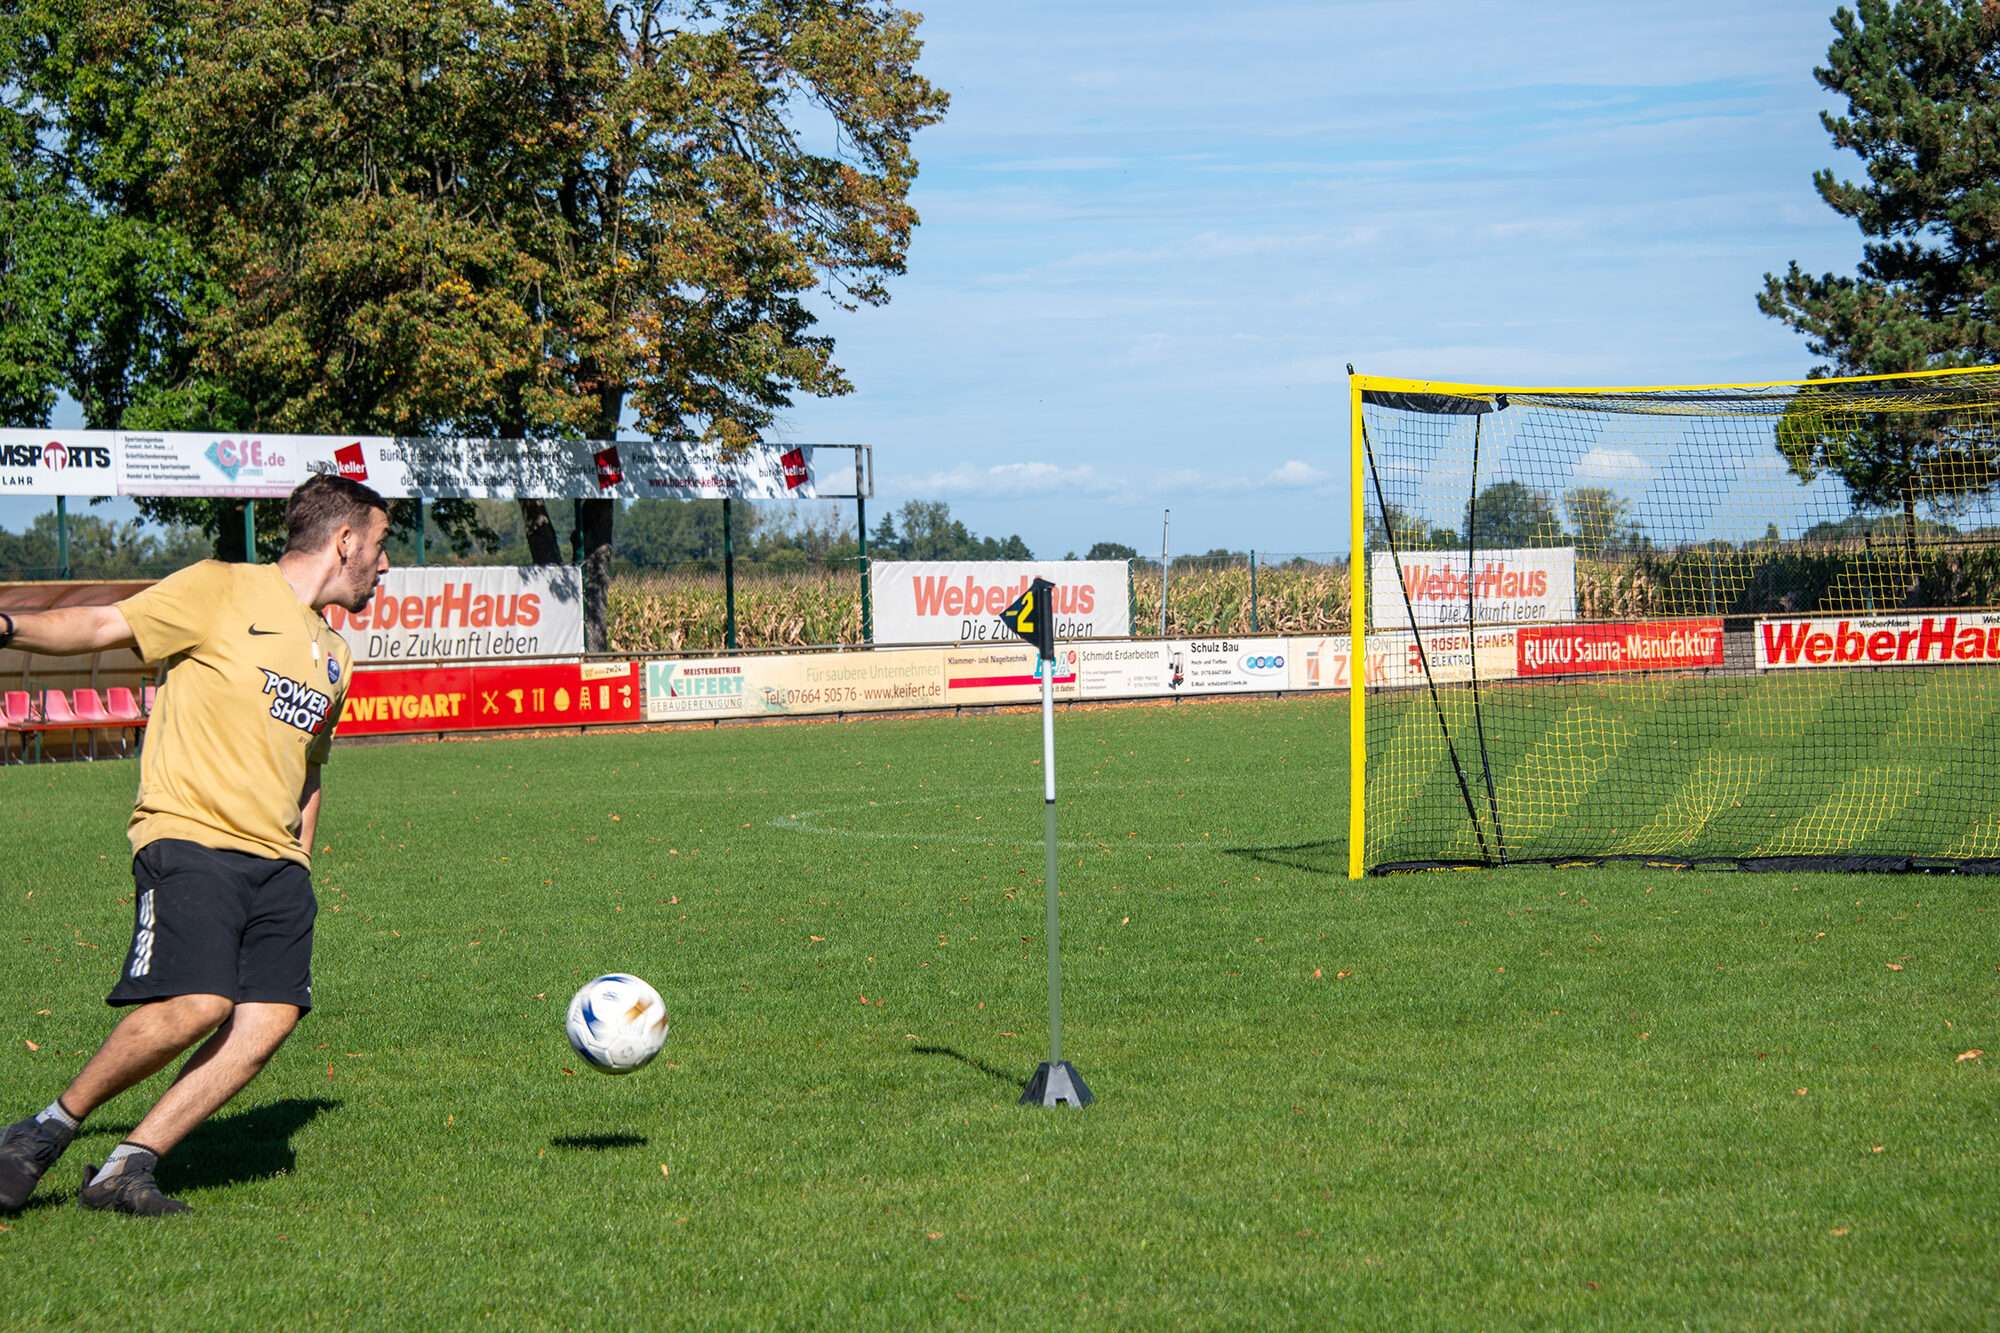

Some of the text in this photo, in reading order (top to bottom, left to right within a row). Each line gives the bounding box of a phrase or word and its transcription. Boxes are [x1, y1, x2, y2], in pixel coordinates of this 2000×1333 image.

[2, 477, 33, 486] LAHR
[1404, 561, 1548, 602] WeberHaus
[913, 576, 1096, 617] Weberus
[1440, 604, 1459, 623] Die
[1513, 600, 1546, 620] leben
[961, 620, 986, 641] Die
[1055, 617, 1093, 640] leben
[369, 631, 539, 658] Die Zukunft leben
[1191, 641, 1239, 653] Schulz Bau
[1334, 638, 1391, 653] SPEION
[1431, 633, 1514, 652] ROSENEHNER
[1524, 630, 1716, 669] RUKU Sauna-Manufaktur
[1082, 649, 1159, 662] Schmidt Erdarbeiten
[650, 664, 744, 698] KEIFERT
[683, 666, 742, 676] MEISTERBETRIEB
[870, 663, 941, 680] Unternehmen
[258, 667, 330, 716] POWER
[788, 688, 821, 704] 07664
[270, 697, 323, 735] SHOT
